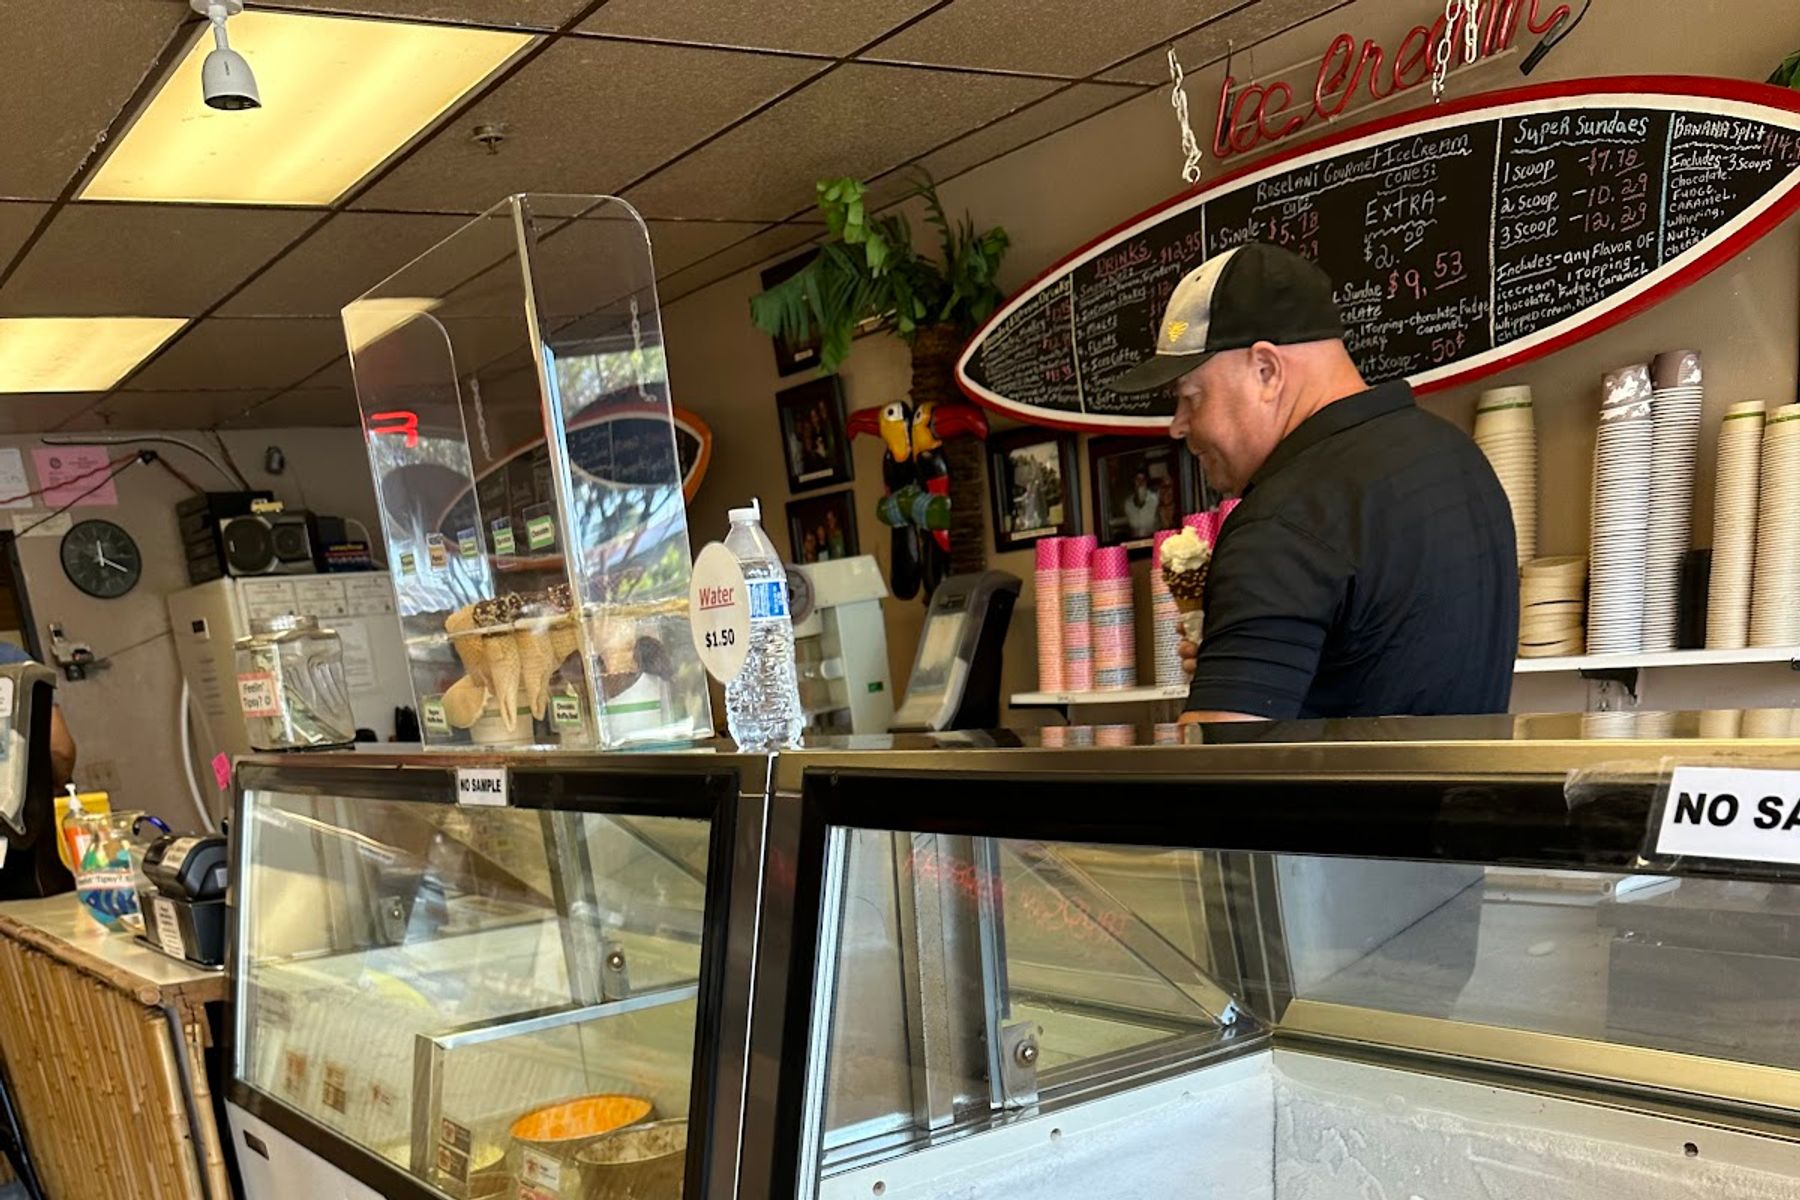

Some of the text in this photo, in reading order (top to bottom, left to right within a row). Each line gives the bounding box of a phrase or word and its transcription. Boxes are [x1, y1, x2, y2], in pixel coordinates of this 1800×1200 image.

[699, 586, 735, 607] Water
[705, 628, 735, 649] $1.50
[460, 778, 502, 793] NO SAMPLE
[1674, 791, 1739, 827] NO
